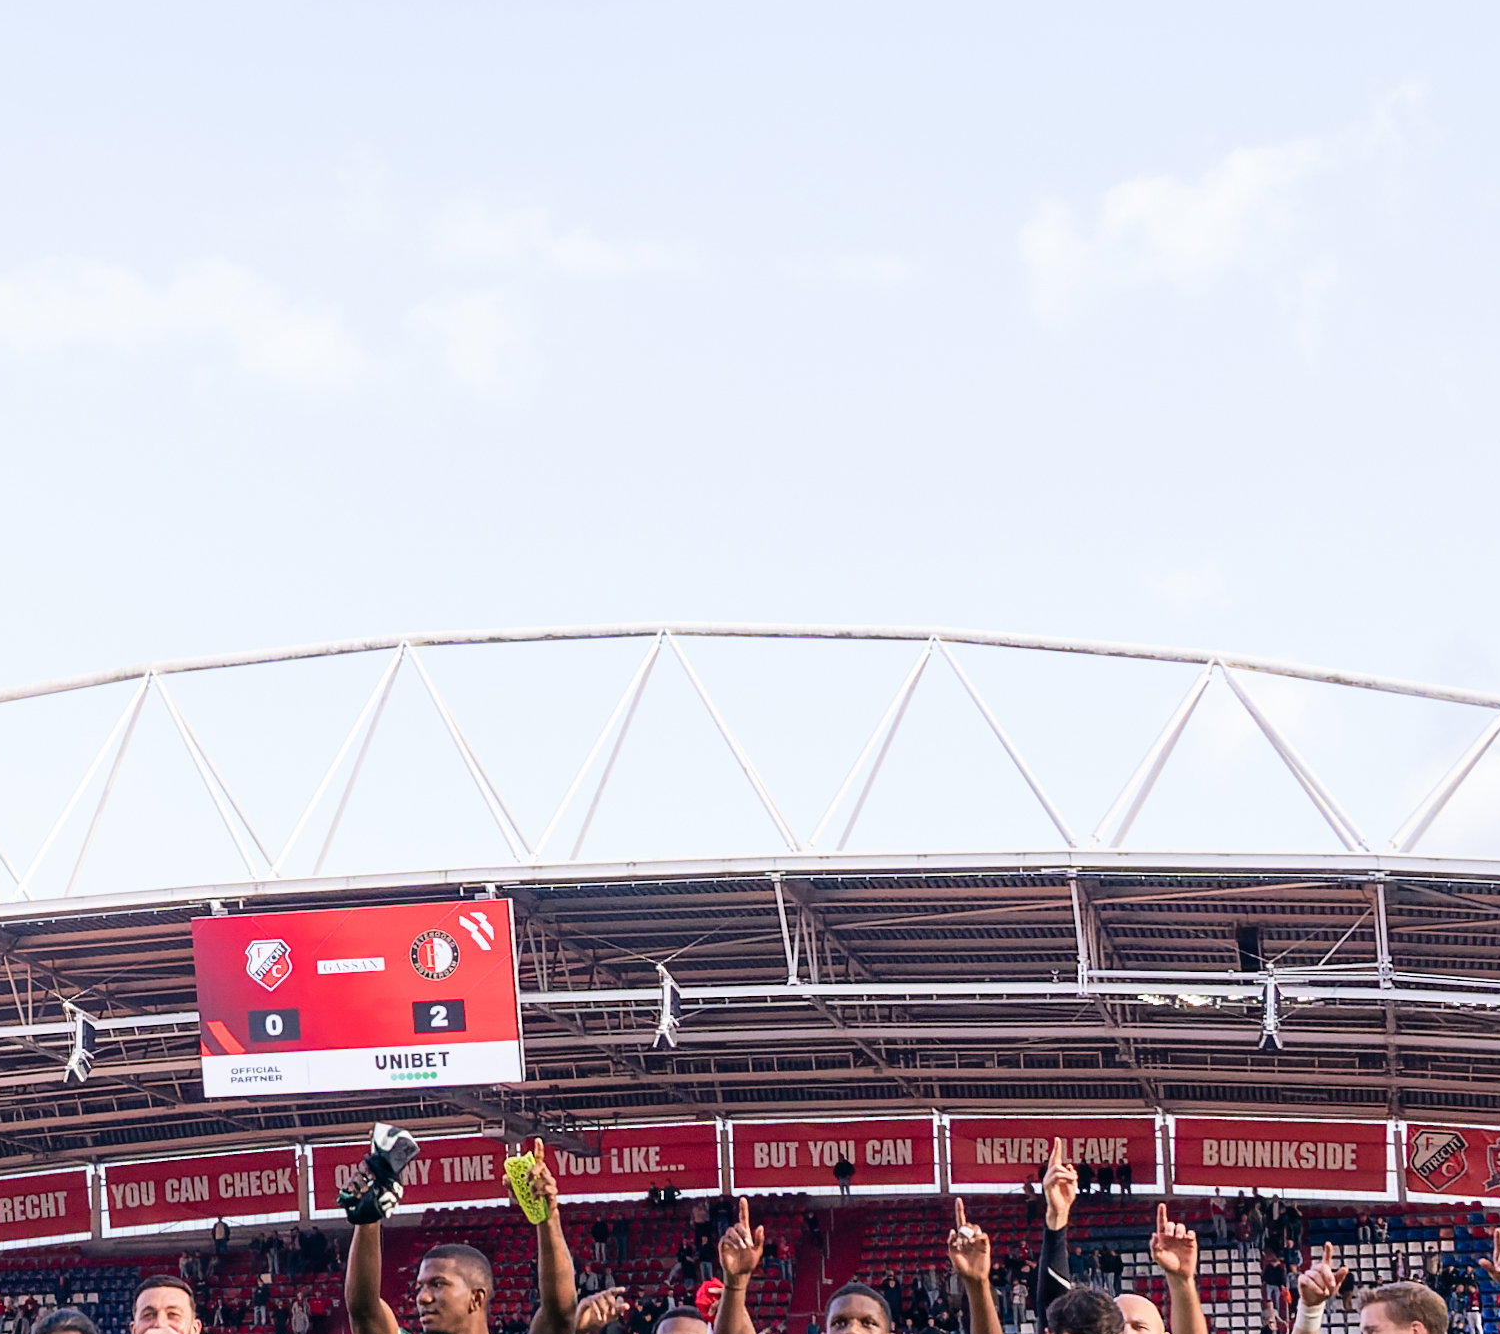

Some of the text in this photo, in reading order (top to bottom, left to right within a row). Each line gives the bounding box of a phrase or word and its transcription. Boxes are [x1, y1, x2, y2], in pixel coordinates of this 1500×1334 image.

[265, 1014, 284, 1036] 0
[429, 1005, 449, 1028] 2
[230, 1065, 281, 1075] OFFICIAL
[375, 1051, 451, 1070] UNIBET
[230, 1074, 283, 1084] PARTNER
[554, 1148, 601, 1177] YOU
[753, 1139, 913, 1169] BUT YOU CAN
[976, 1137, 1128, 1164] NEVER LEAVE
[1202, 1138, 1358, 1170] BUNNIKSIDE
[1416, 1137, 1466, 1177] UTRECHT
[439, 1154, 494, 1182] TIME
[110, 1167, 294, 1210] YOU CAN CHECK
